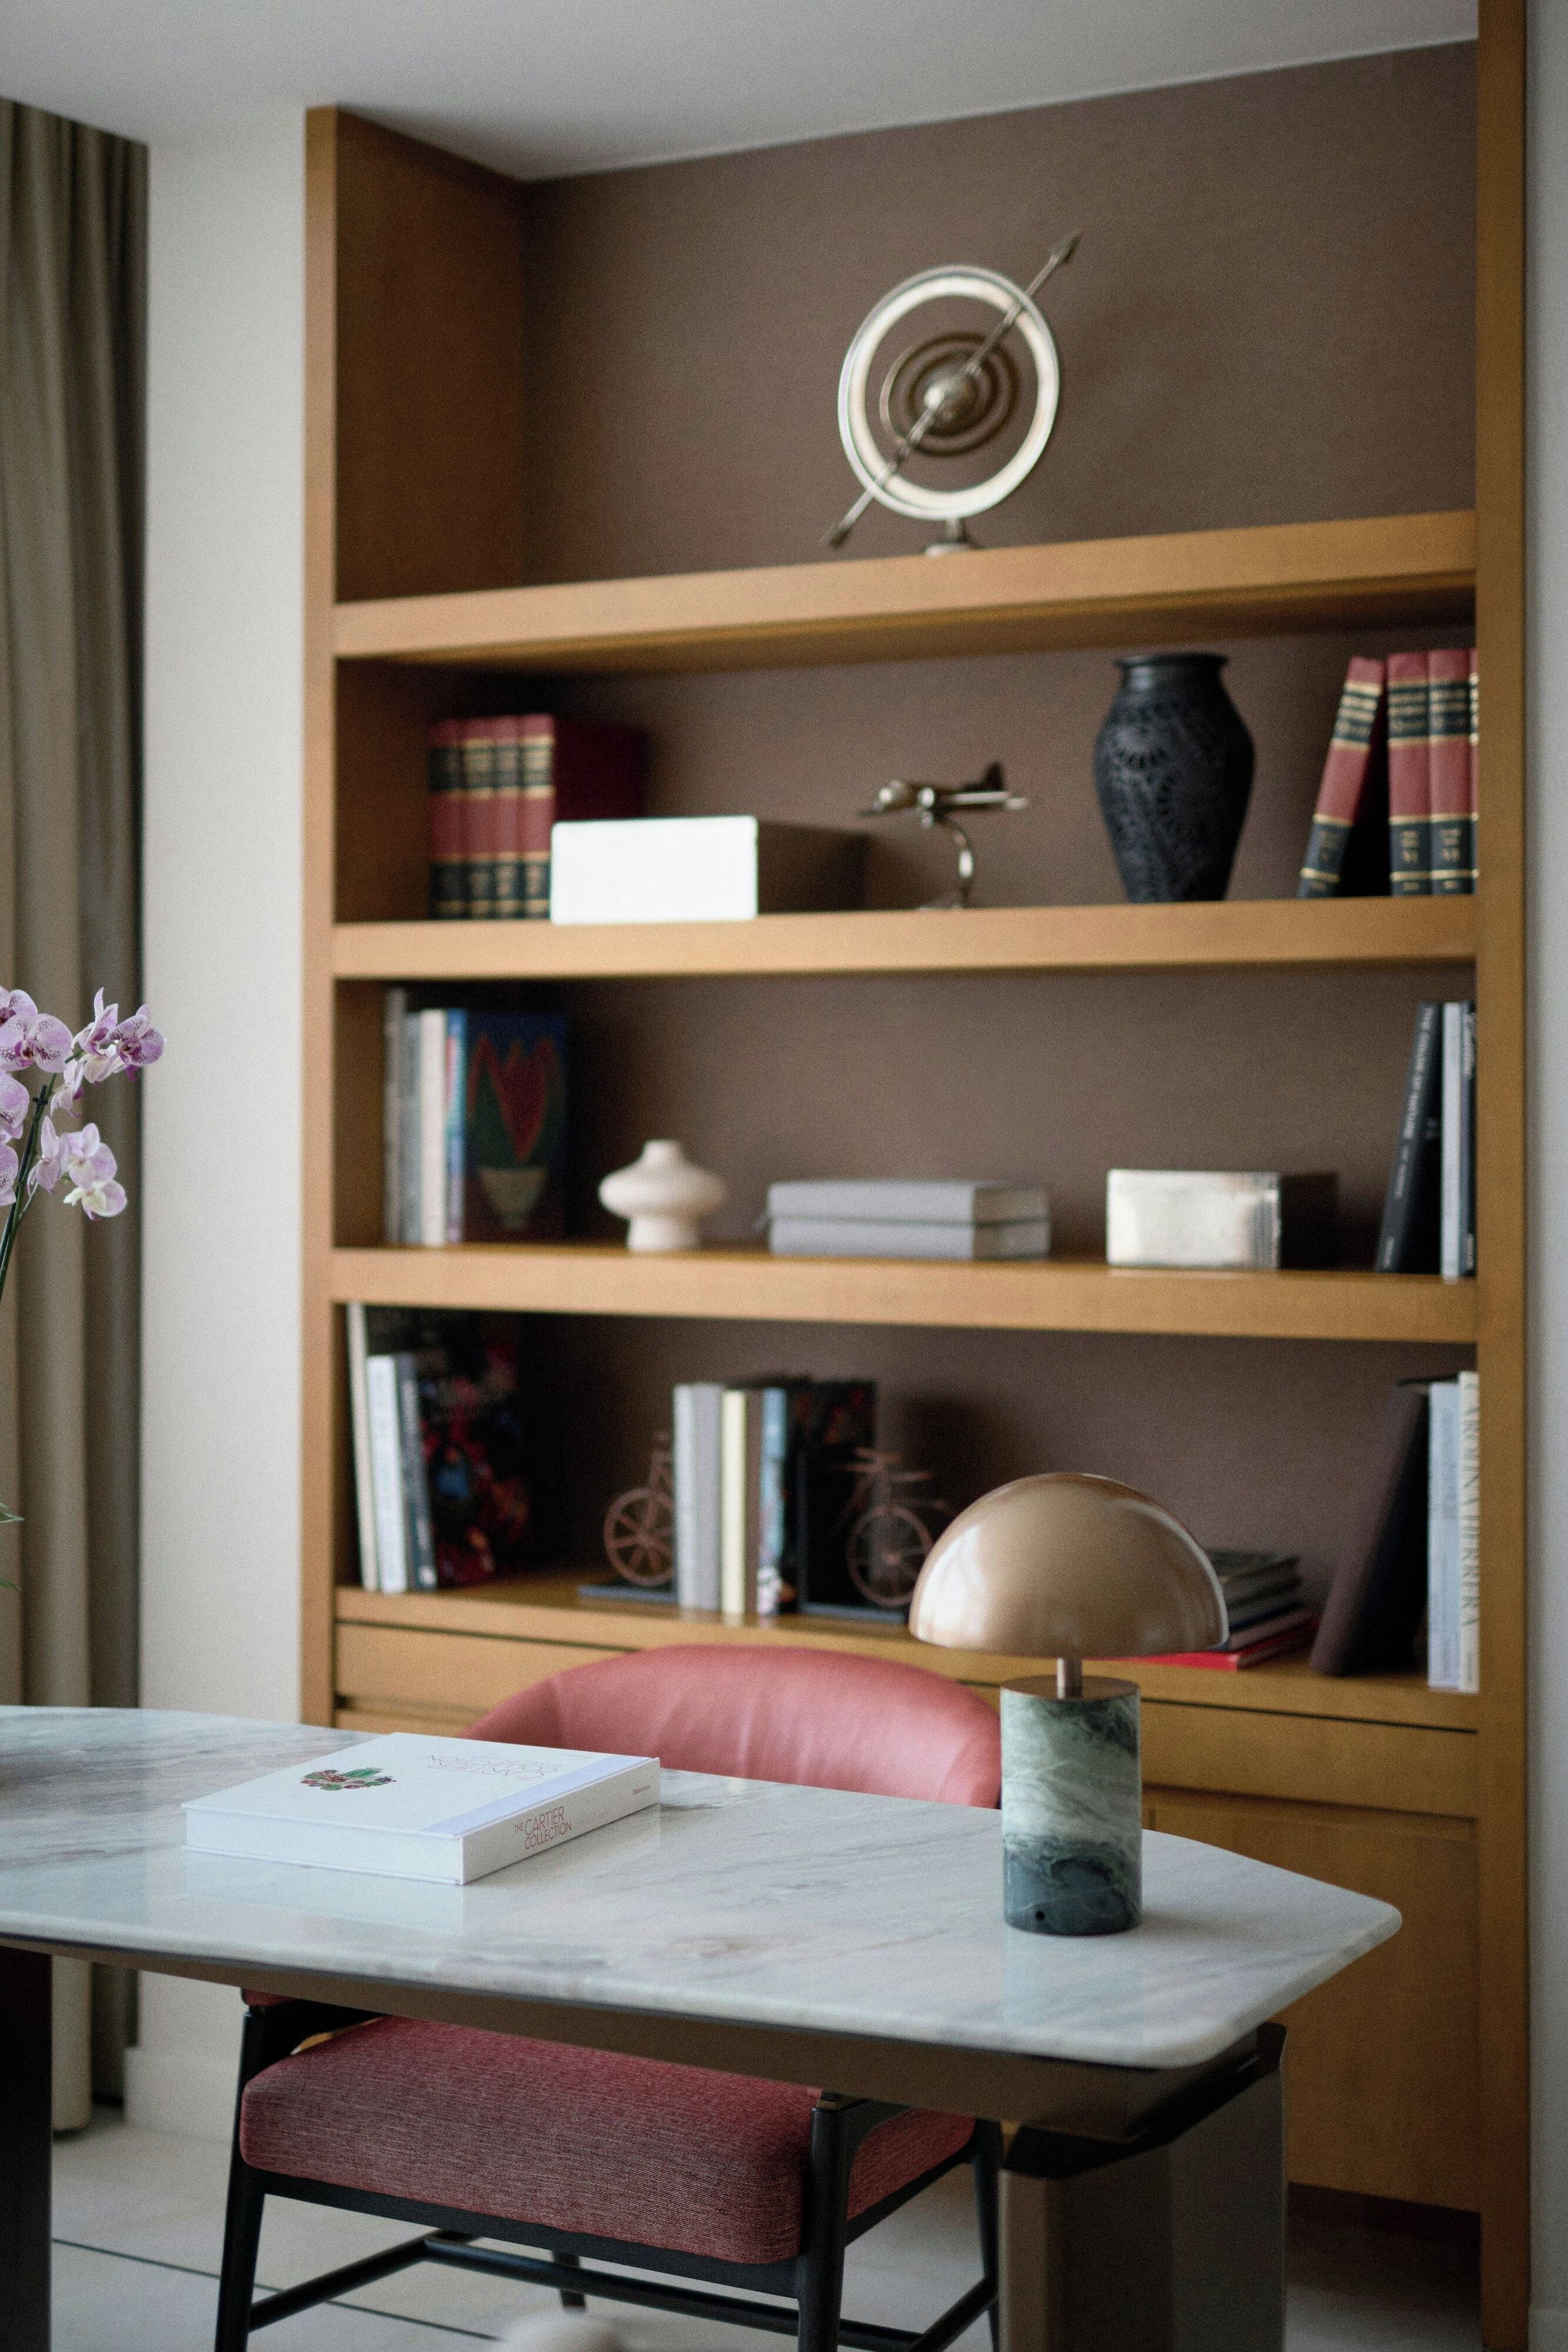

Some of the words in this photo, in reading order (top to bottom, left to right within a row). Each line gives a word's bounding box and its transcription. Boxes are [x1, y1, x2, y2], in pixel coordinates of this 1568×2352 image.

[422, 1754, 558, 1773] COLLECTION
[428, 1761, 544, 1778] CARTIER
[513, 1822, 524, 1833] THE
[525, 1806, 565, 1836] CARTIER
[524, 1819, 572, 1850] COLLECTION
